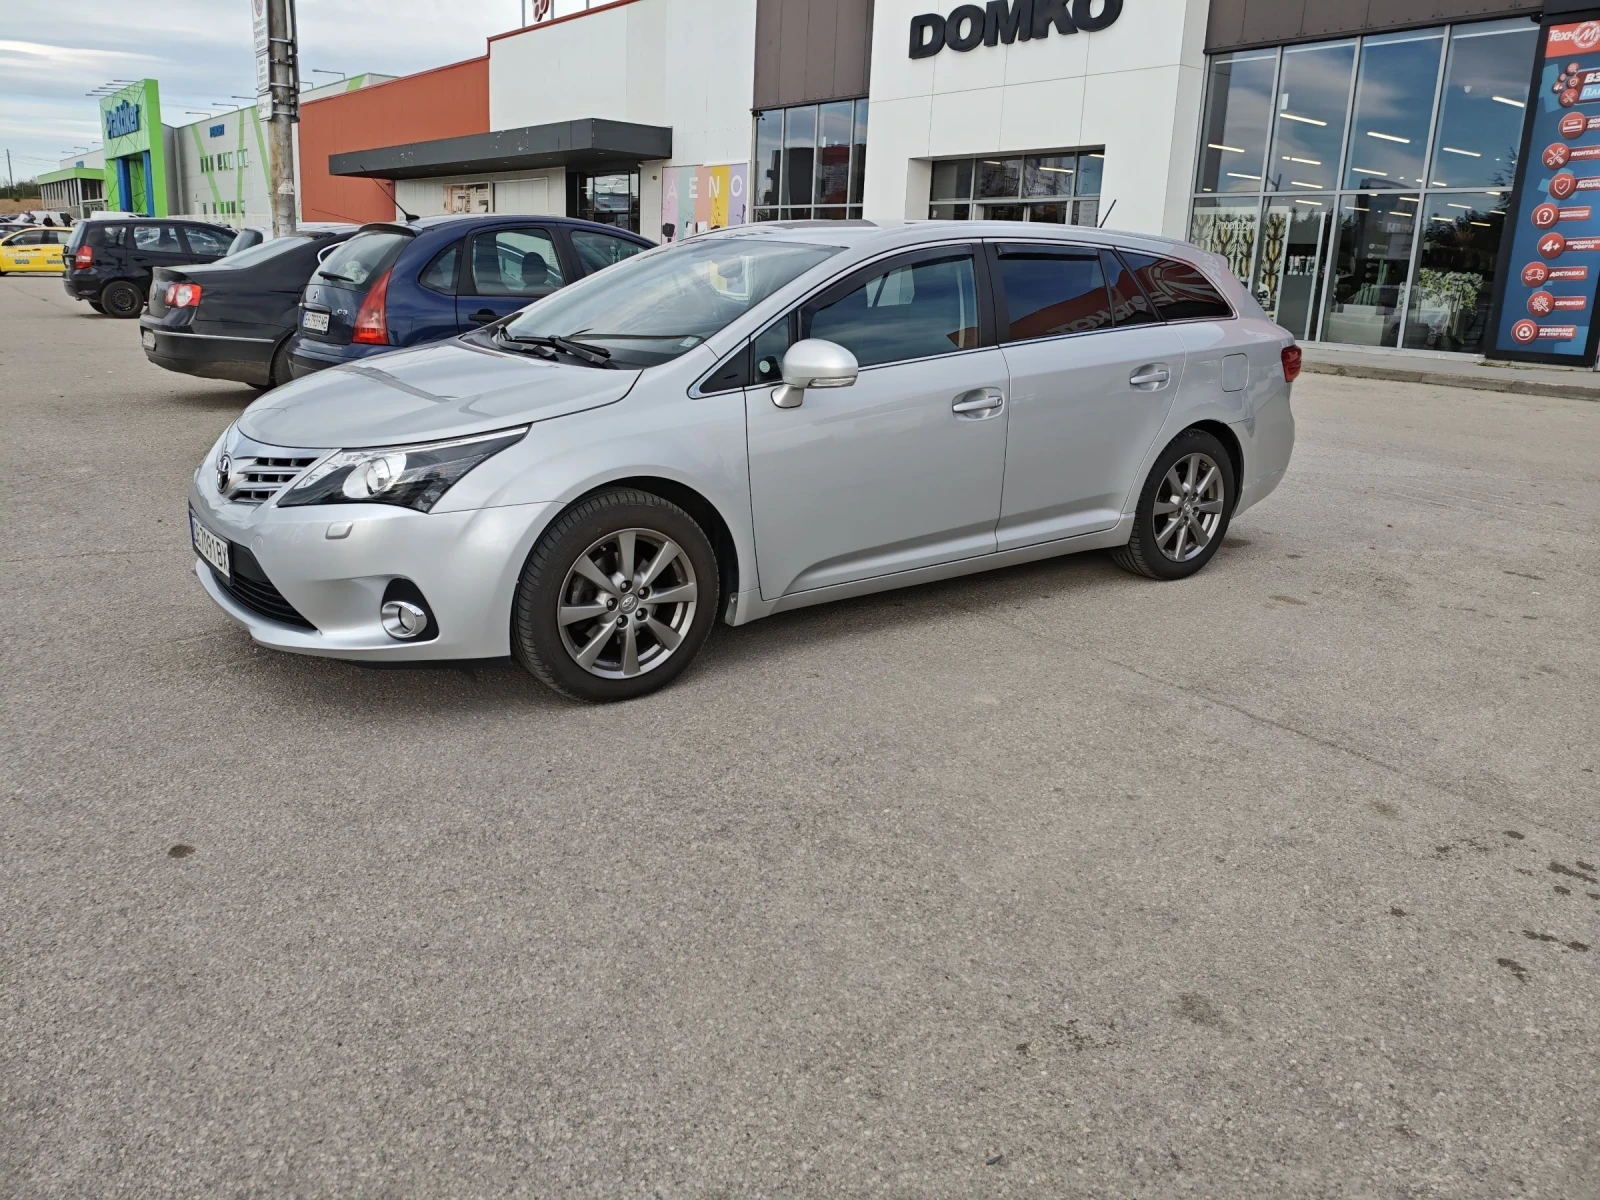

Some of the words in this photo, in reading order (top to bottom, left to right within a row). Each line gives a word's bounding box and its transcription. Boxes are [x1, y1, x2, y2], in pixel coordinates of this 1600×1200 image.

[908, 0, 1124, 59] DOMKO
[105, 99, 140, 139] Praktiker
[666, 174, 743, 199] AENO
